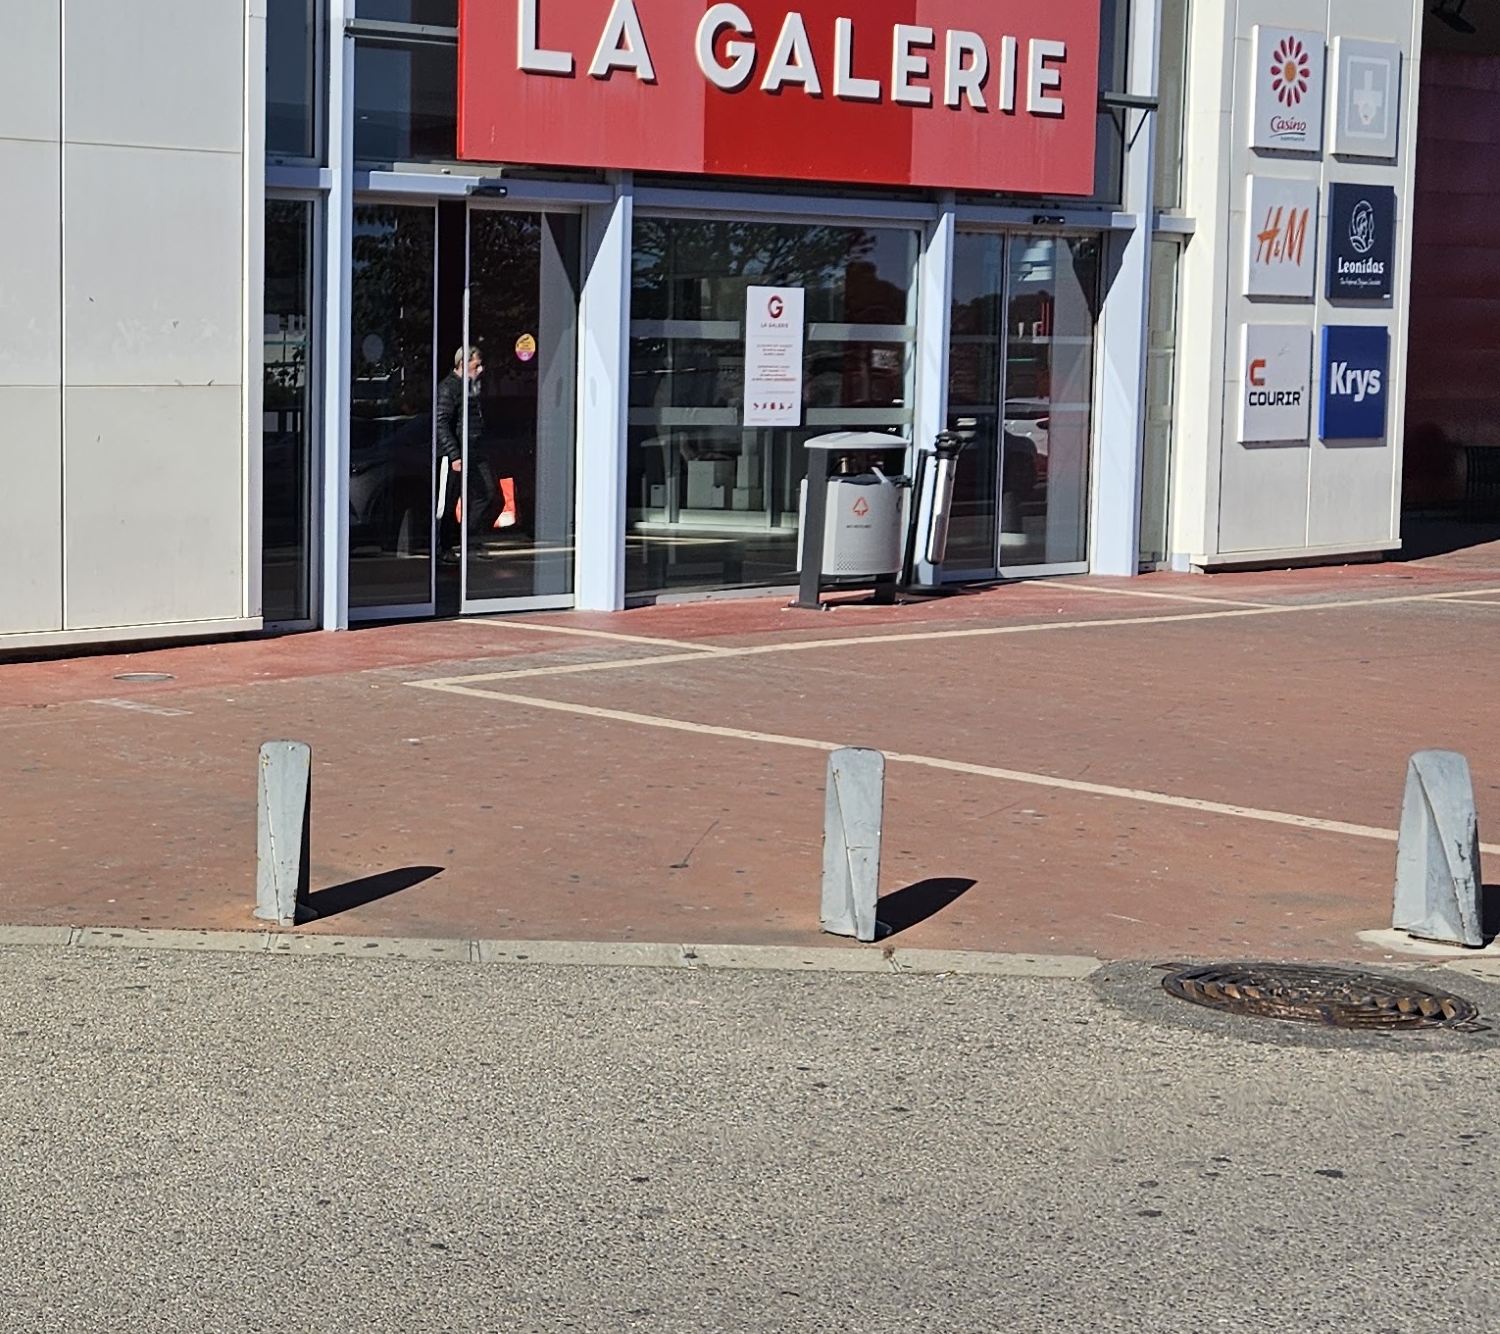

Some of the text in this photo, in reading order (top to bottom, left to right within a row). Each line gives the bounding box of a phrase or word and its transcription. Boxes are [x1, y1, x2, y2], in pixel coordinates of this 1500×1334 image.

[695, 2, 1067, 116] GALERIE
[1270, 115, 1307, 133] Casino
[1256, 205, 1310, 267] H&M
[1337, 257, 1385, 274] Leonidas
[768, 295, 784, 319] G
[1330, 361, 1382, 403] Krys
[1249, 391, 1301, 407] COURIR
